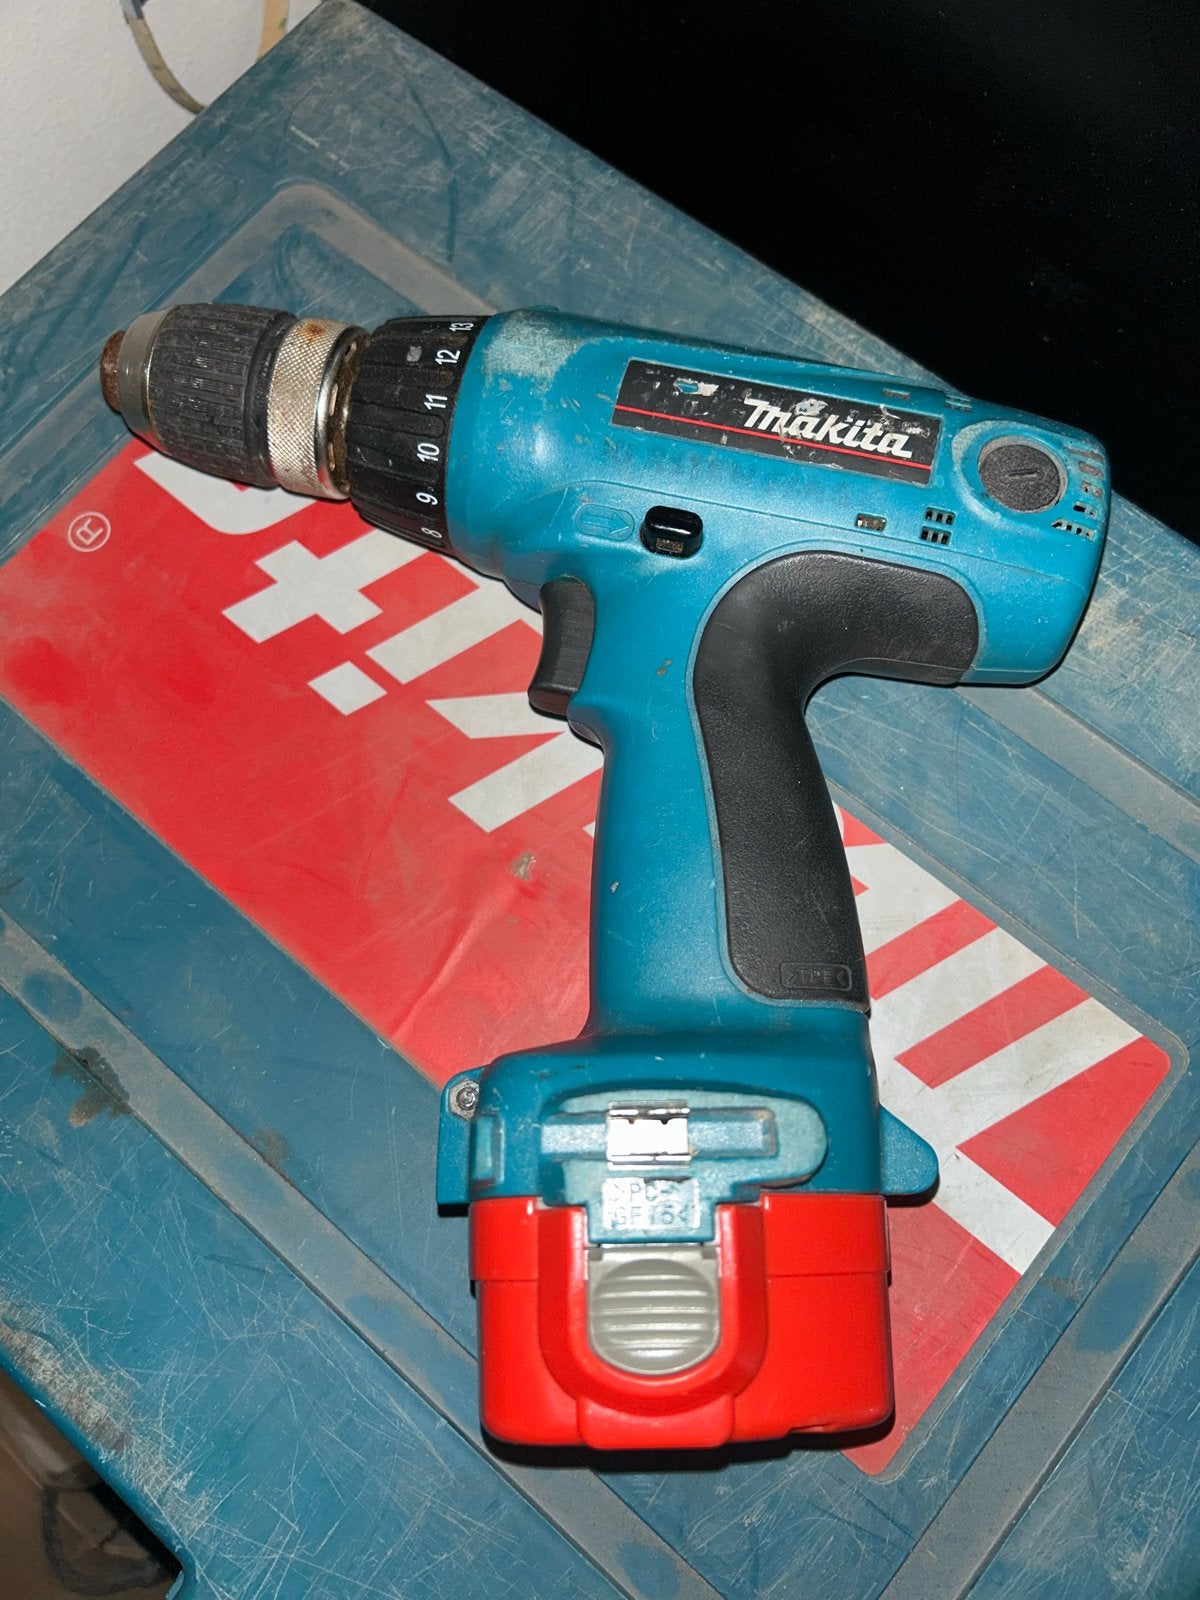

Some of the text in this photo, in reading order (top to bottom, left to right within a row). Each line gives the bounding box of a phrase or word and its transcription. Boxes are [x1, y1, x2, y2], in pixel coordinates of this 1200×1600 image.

[449, 321, 474, 332] 13
[435, 349, 461, 365] 12
[423, 393, 448, 410] 11
[416, 442, 440, 462] 10
[415, 491, 438, 506] 9
[420, 527, 443, 539] 8
